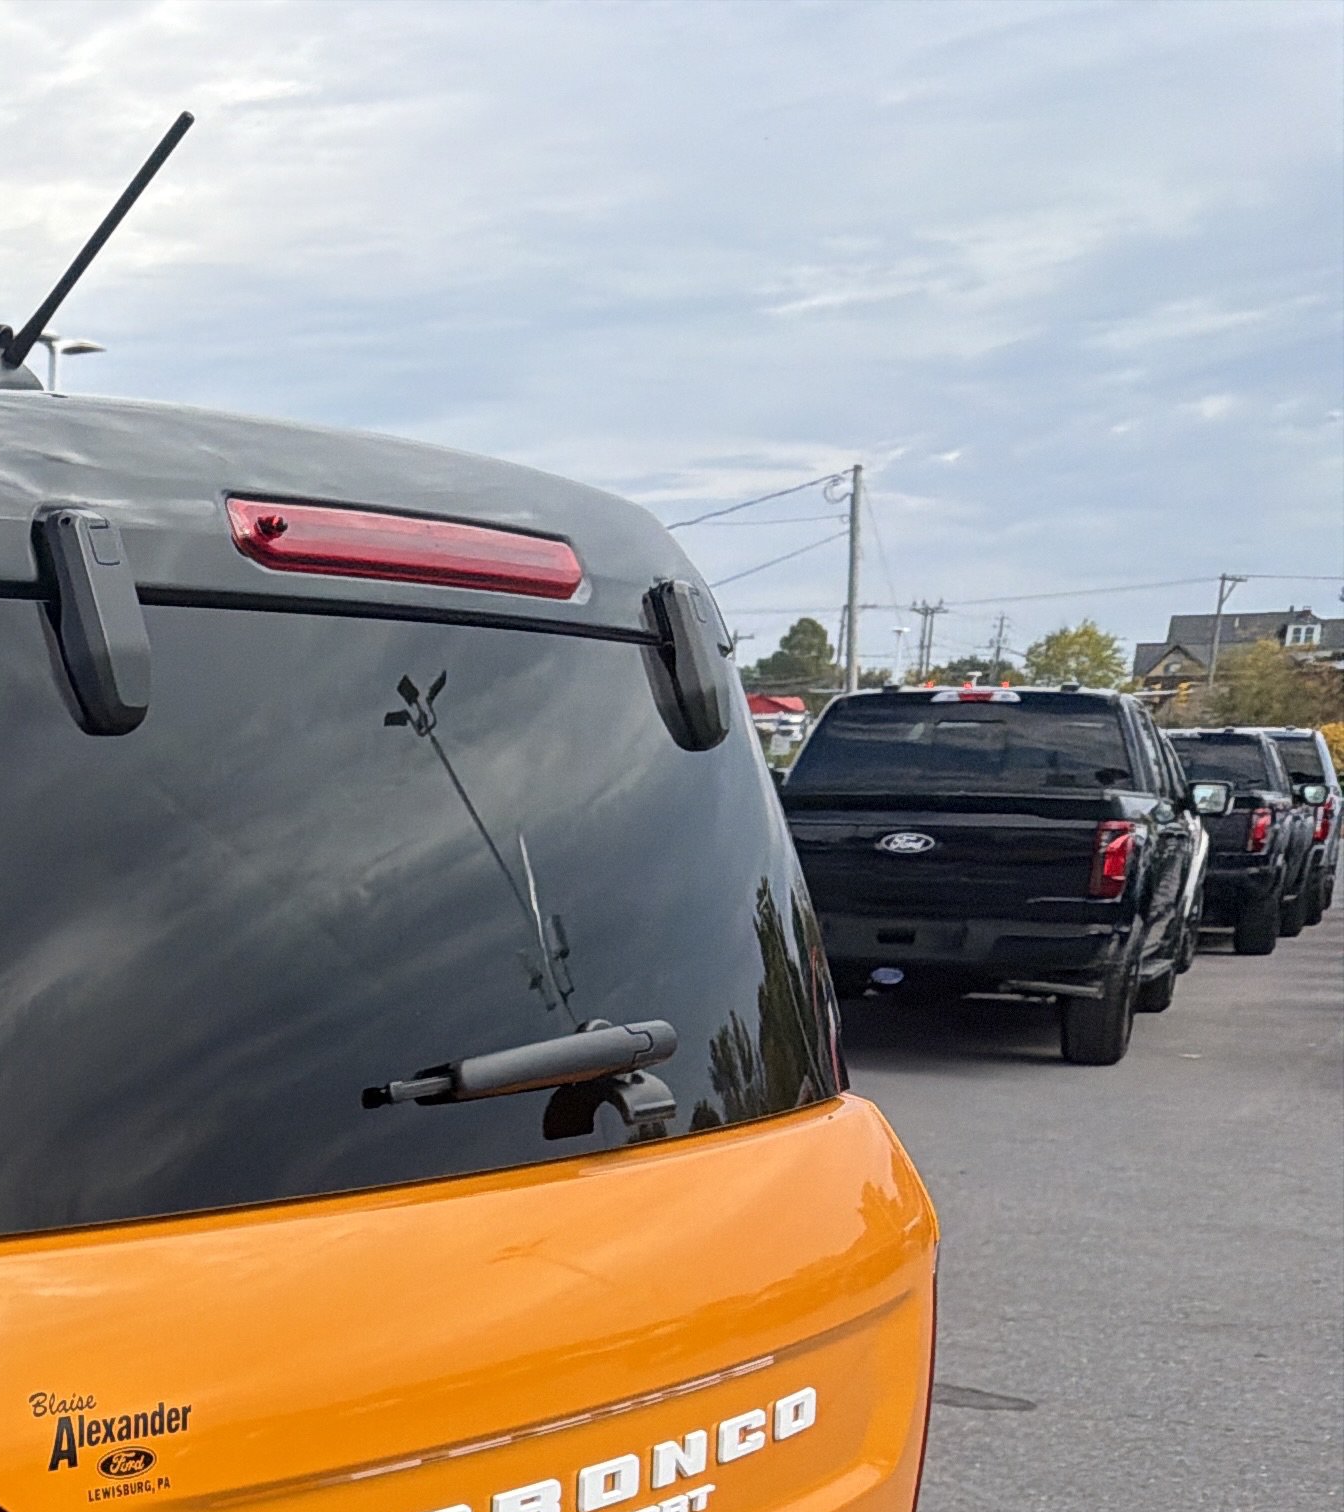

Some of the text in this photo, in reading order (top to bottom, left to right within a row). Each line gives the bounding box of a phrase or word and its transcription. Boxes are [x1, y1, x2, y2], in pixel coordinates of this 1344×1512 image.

[28, 1392, 97, 1418] Blaise
[47, 1402, 192, 1472] Alexander
[87, 1476, 171, 1502] LEWISBURG, PA
